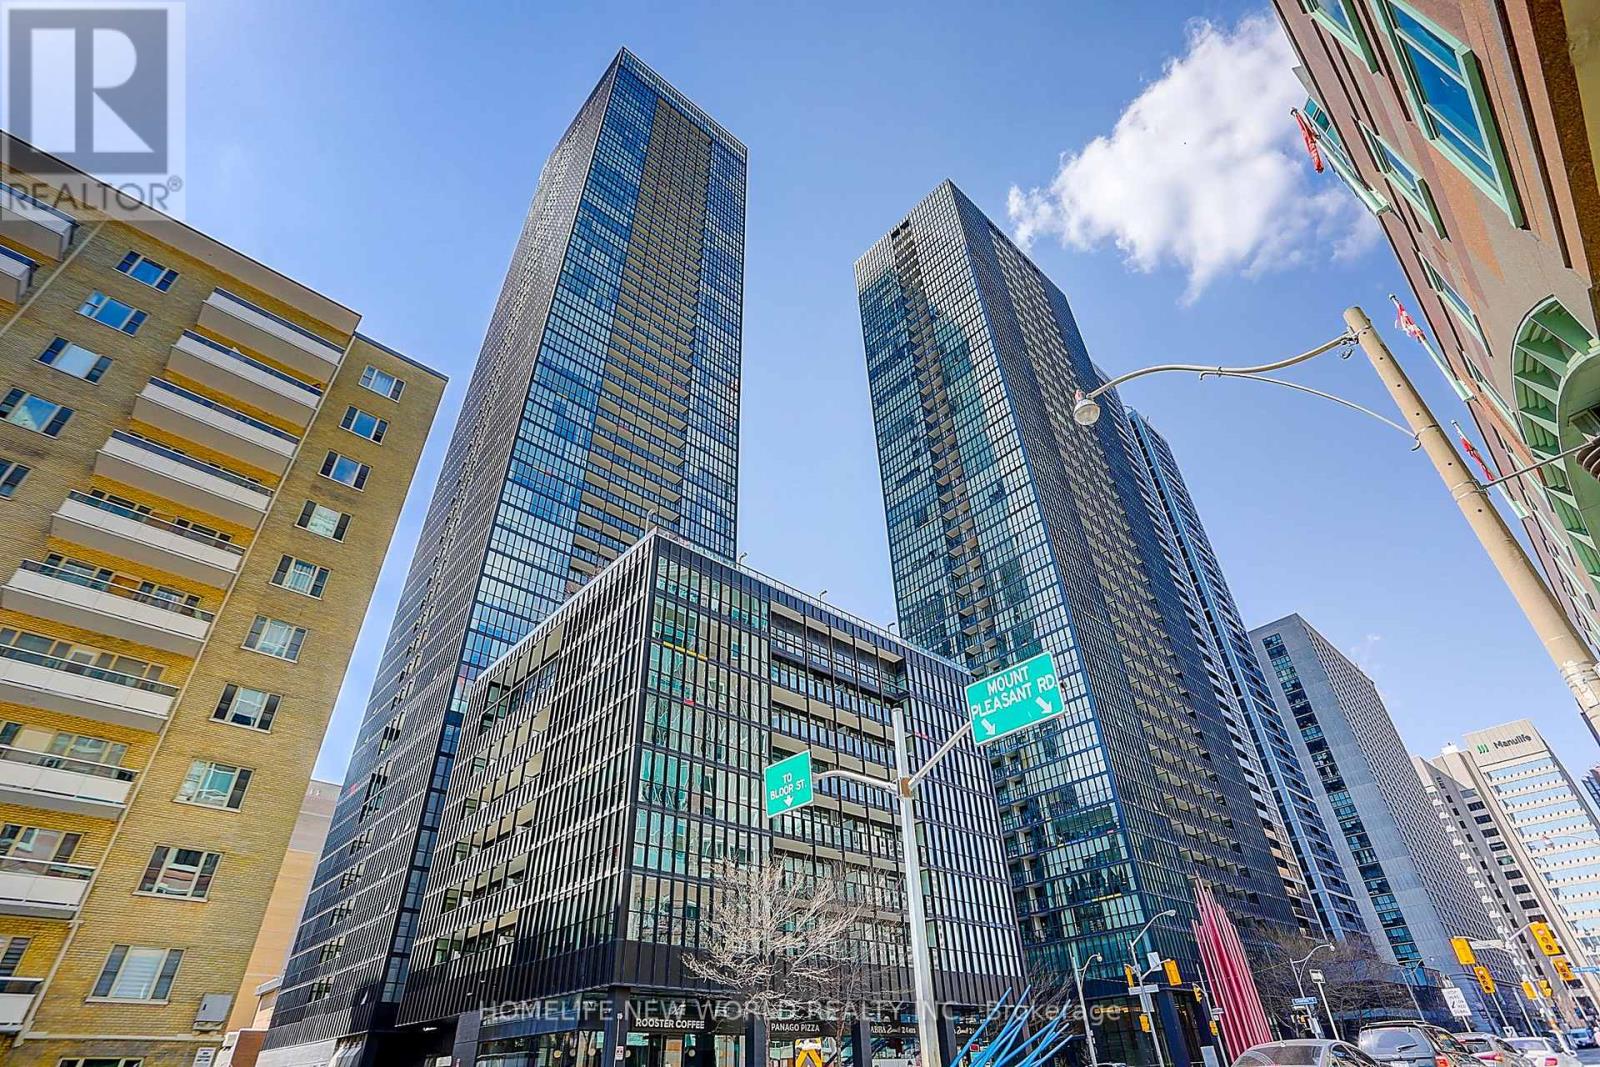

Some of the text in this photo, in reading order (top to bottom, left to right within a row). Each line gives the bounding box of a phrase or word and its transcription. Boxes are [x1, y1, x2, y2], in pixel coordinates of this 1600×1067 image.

[987, 665, 1029, 697] MOUNT
[971, 682, 1032, 720] PLEASANT
[1493, 734, 1532, 749] Manulife
[783, 772, 793, 784] TO
[635, 1018, 705, 1029] ROOSTER COFFEE
[771, 1023, 820, 1032] PANAGO PIZZA
